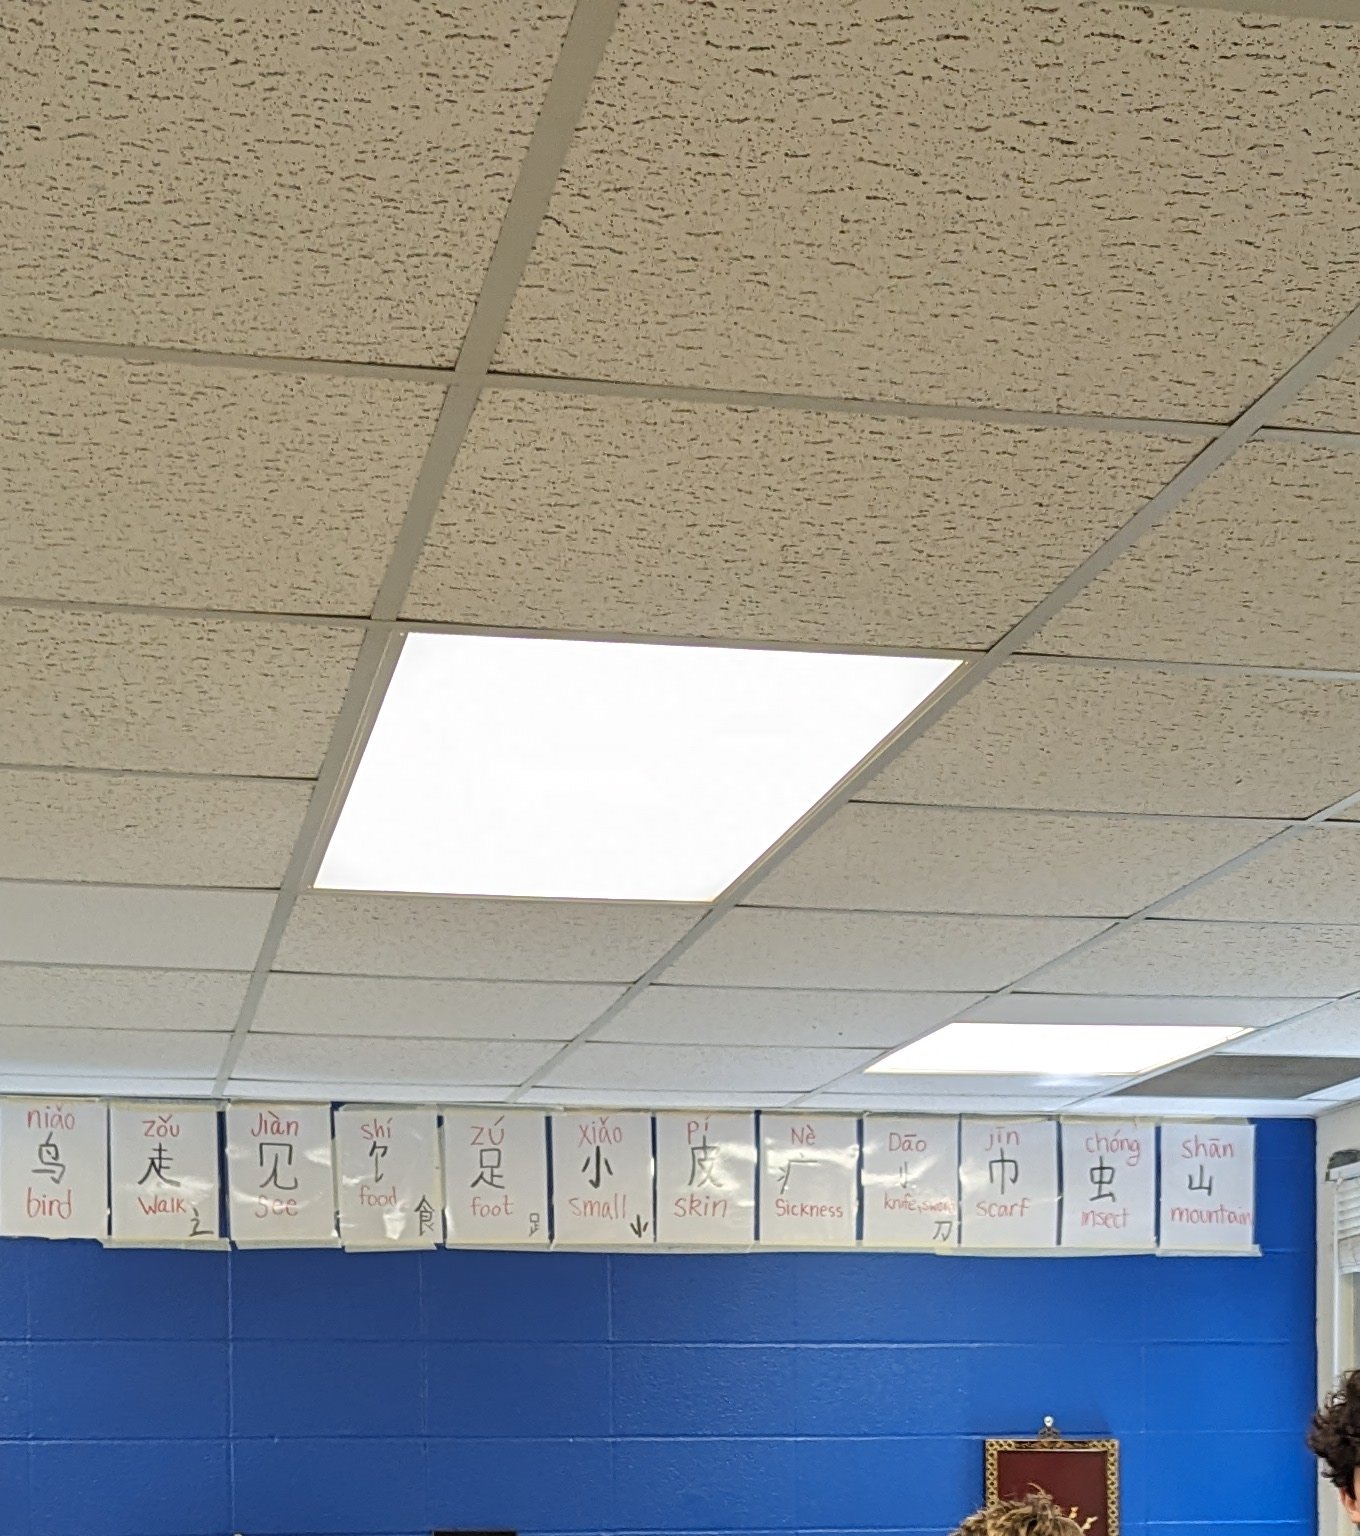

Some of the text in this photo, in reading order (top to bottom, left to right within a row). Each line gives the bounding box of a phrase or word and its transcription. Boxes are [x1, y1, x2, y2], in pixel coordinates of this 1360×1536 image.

[137, 1142, 181, 1187] 走
[259, 1142, 298, 1190] 见
[470, 1147, 506, 1190] 足
[581, 1145, 613, 1190] 小
[989, 1147, 1019, 1195] 巾
[1089, 1156, 1116, 1203] 虫
[1188, 1165, 1214, 1197] 山
[26, 1187, 73, 1219] bird
[358, 1185, 397, 1208] food
[469, 1195, 514, 1217] foot
[1170, 1206, 1253, 1226] mountain
